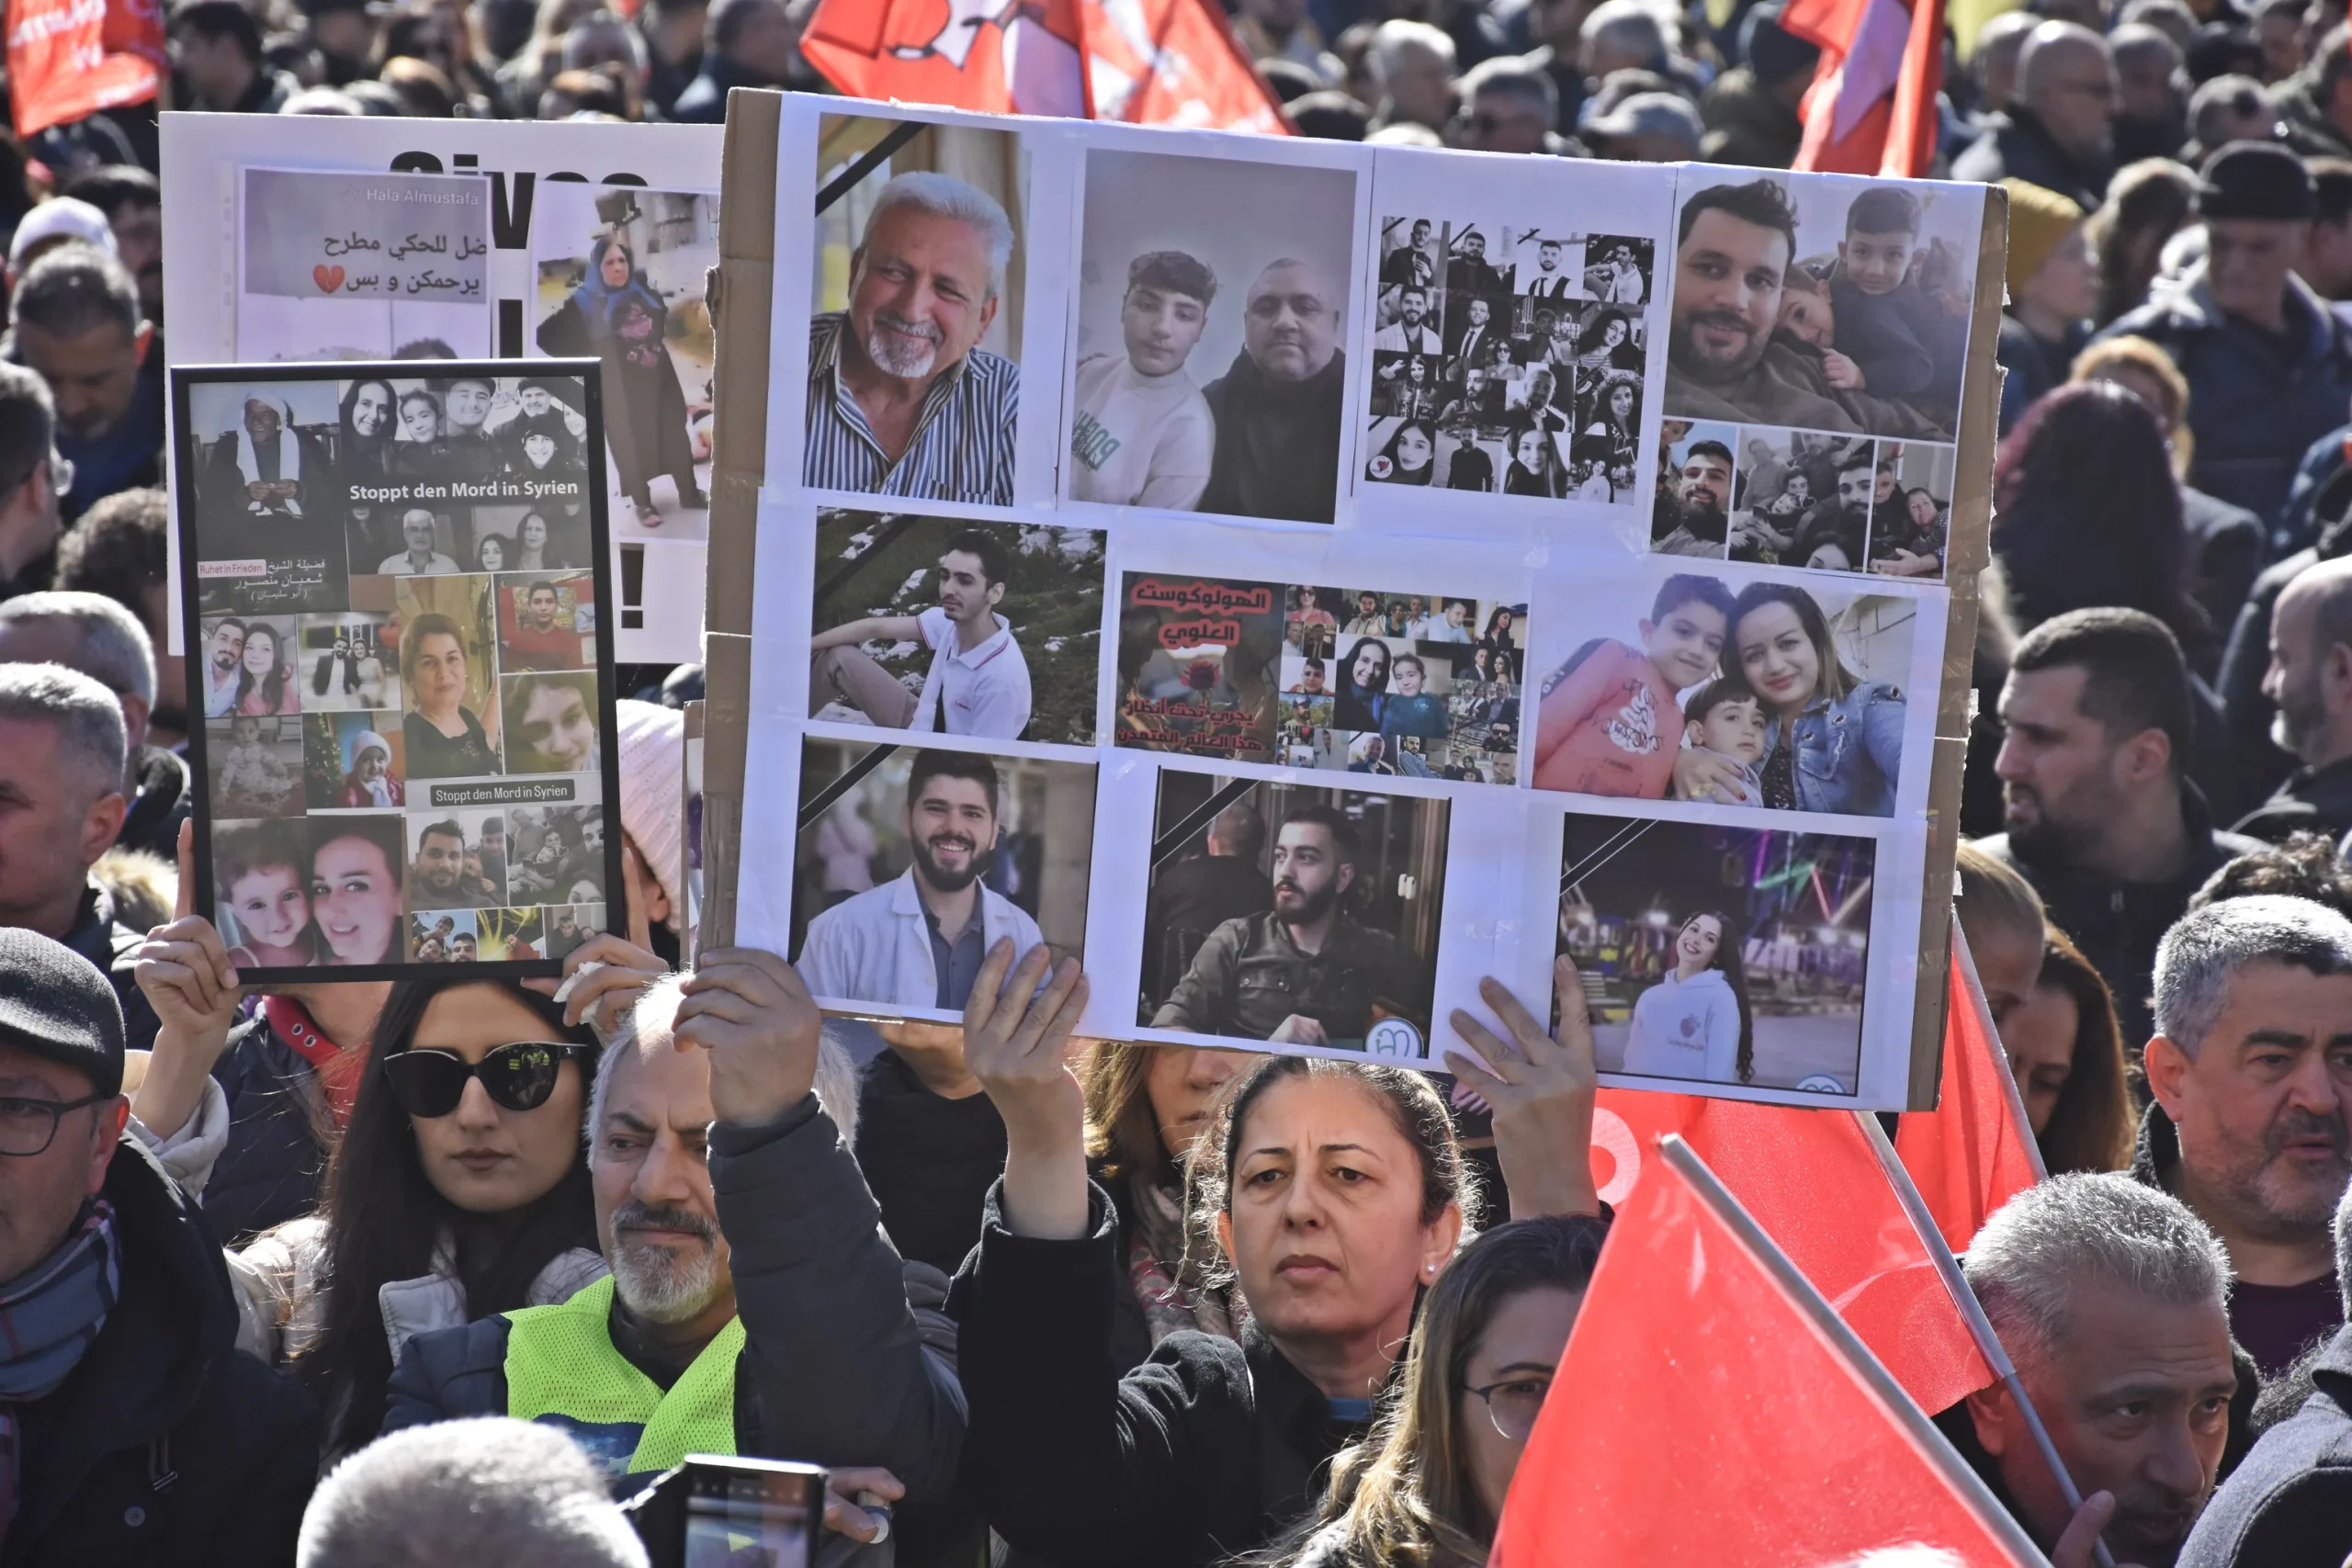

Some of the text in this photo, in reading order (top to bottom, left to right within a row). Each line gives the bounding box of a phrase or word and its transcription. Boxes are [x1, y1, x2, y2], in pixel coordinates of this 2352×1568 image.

[367, 187, 479, 205] Hala Almustafa
[324, 231, 380, 256] مطرح
[389, 233, 447, 261] للحكي
[345, 270, 480, 294] يرحمكن و بس
[349, 480, 578, 502] Stoppt den Mord in Syrien
[232, 563, 263, 573] Frieden
[266, 558, 325, 574] فضيلة الشيخ
[1136, 583, 1267, 611] الهولوكوست
[1162, 622, 1236, 645] العلوي
[435, 784, 568, 804] Stoppt den Mord in Syrien
